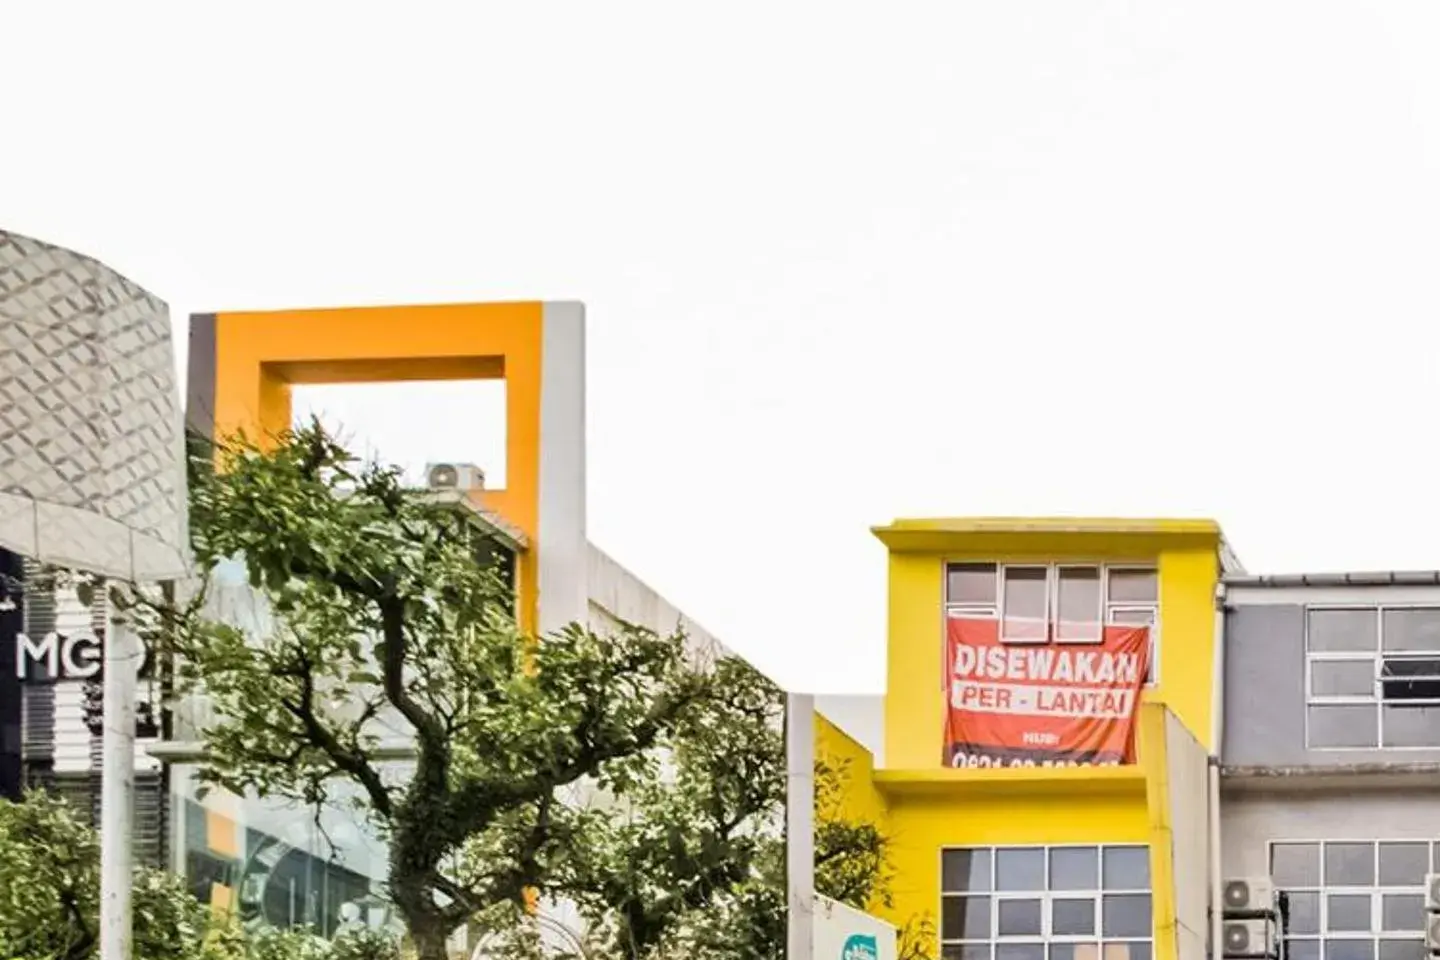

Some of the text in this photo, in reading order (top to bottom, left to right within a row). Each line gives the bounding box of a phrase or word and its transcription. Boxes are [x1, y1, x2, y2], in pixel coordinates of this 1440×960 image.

[954, 643, 1139, 683] DISEWAKAN
[962, 686, 1012, 708] PER
[1037, 690, 1126, 714] LANTAI
